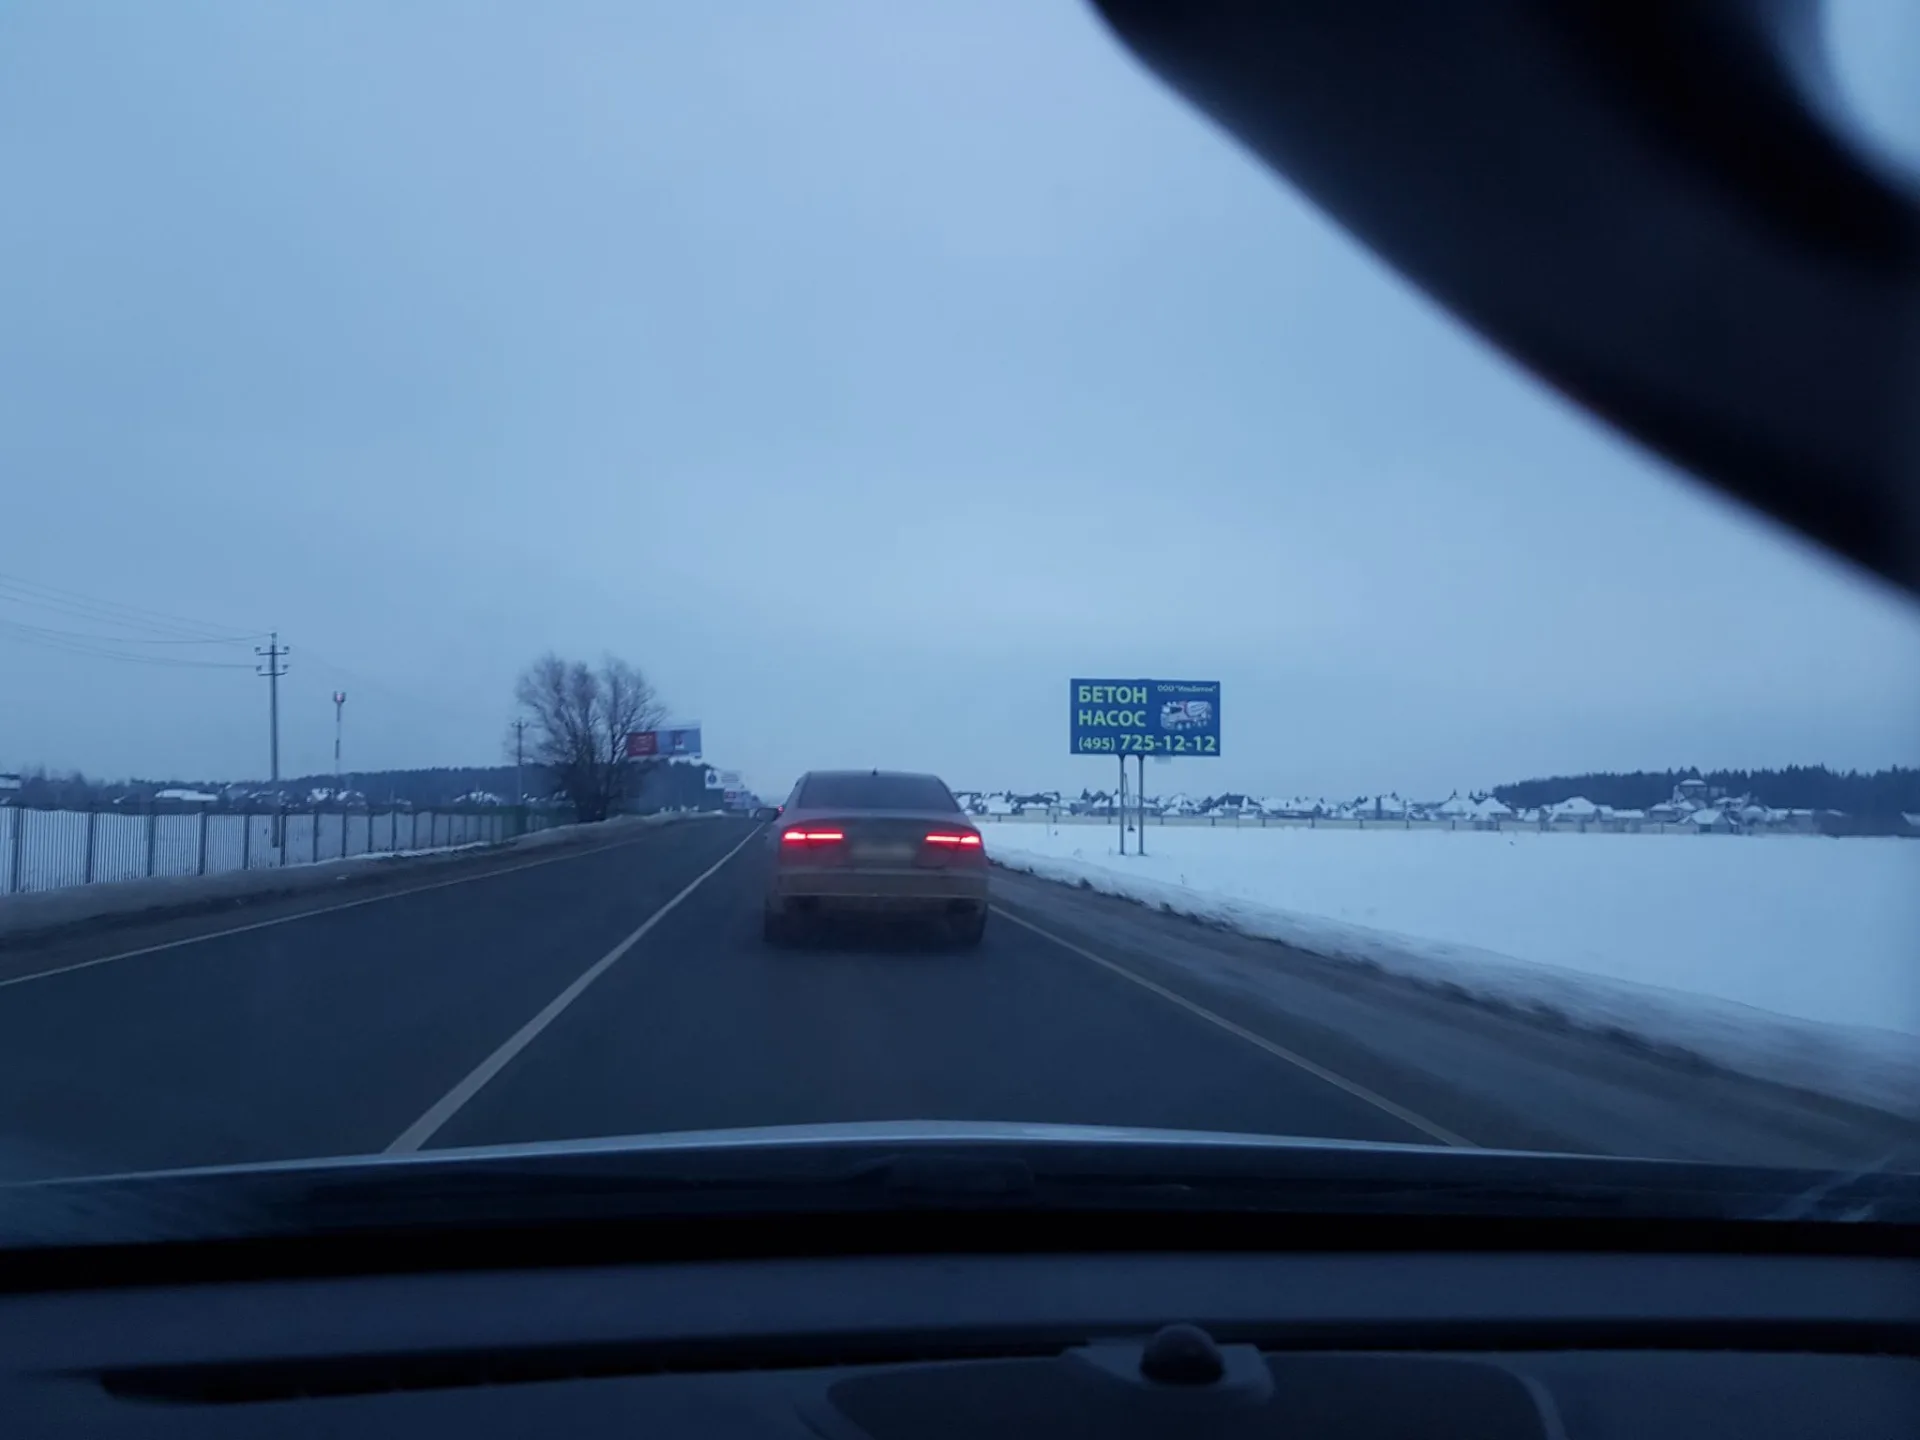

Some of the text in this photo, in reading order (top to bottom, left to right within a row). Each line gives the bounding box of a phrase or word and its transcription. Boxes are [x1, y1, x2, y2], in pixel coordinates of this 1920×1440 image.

[1079, 685, 1147, 704] БЕТОН
[1079, 709, 1146, 727] НАСОС
[1079, 734, 1216, 752] (495) 725-12-12
